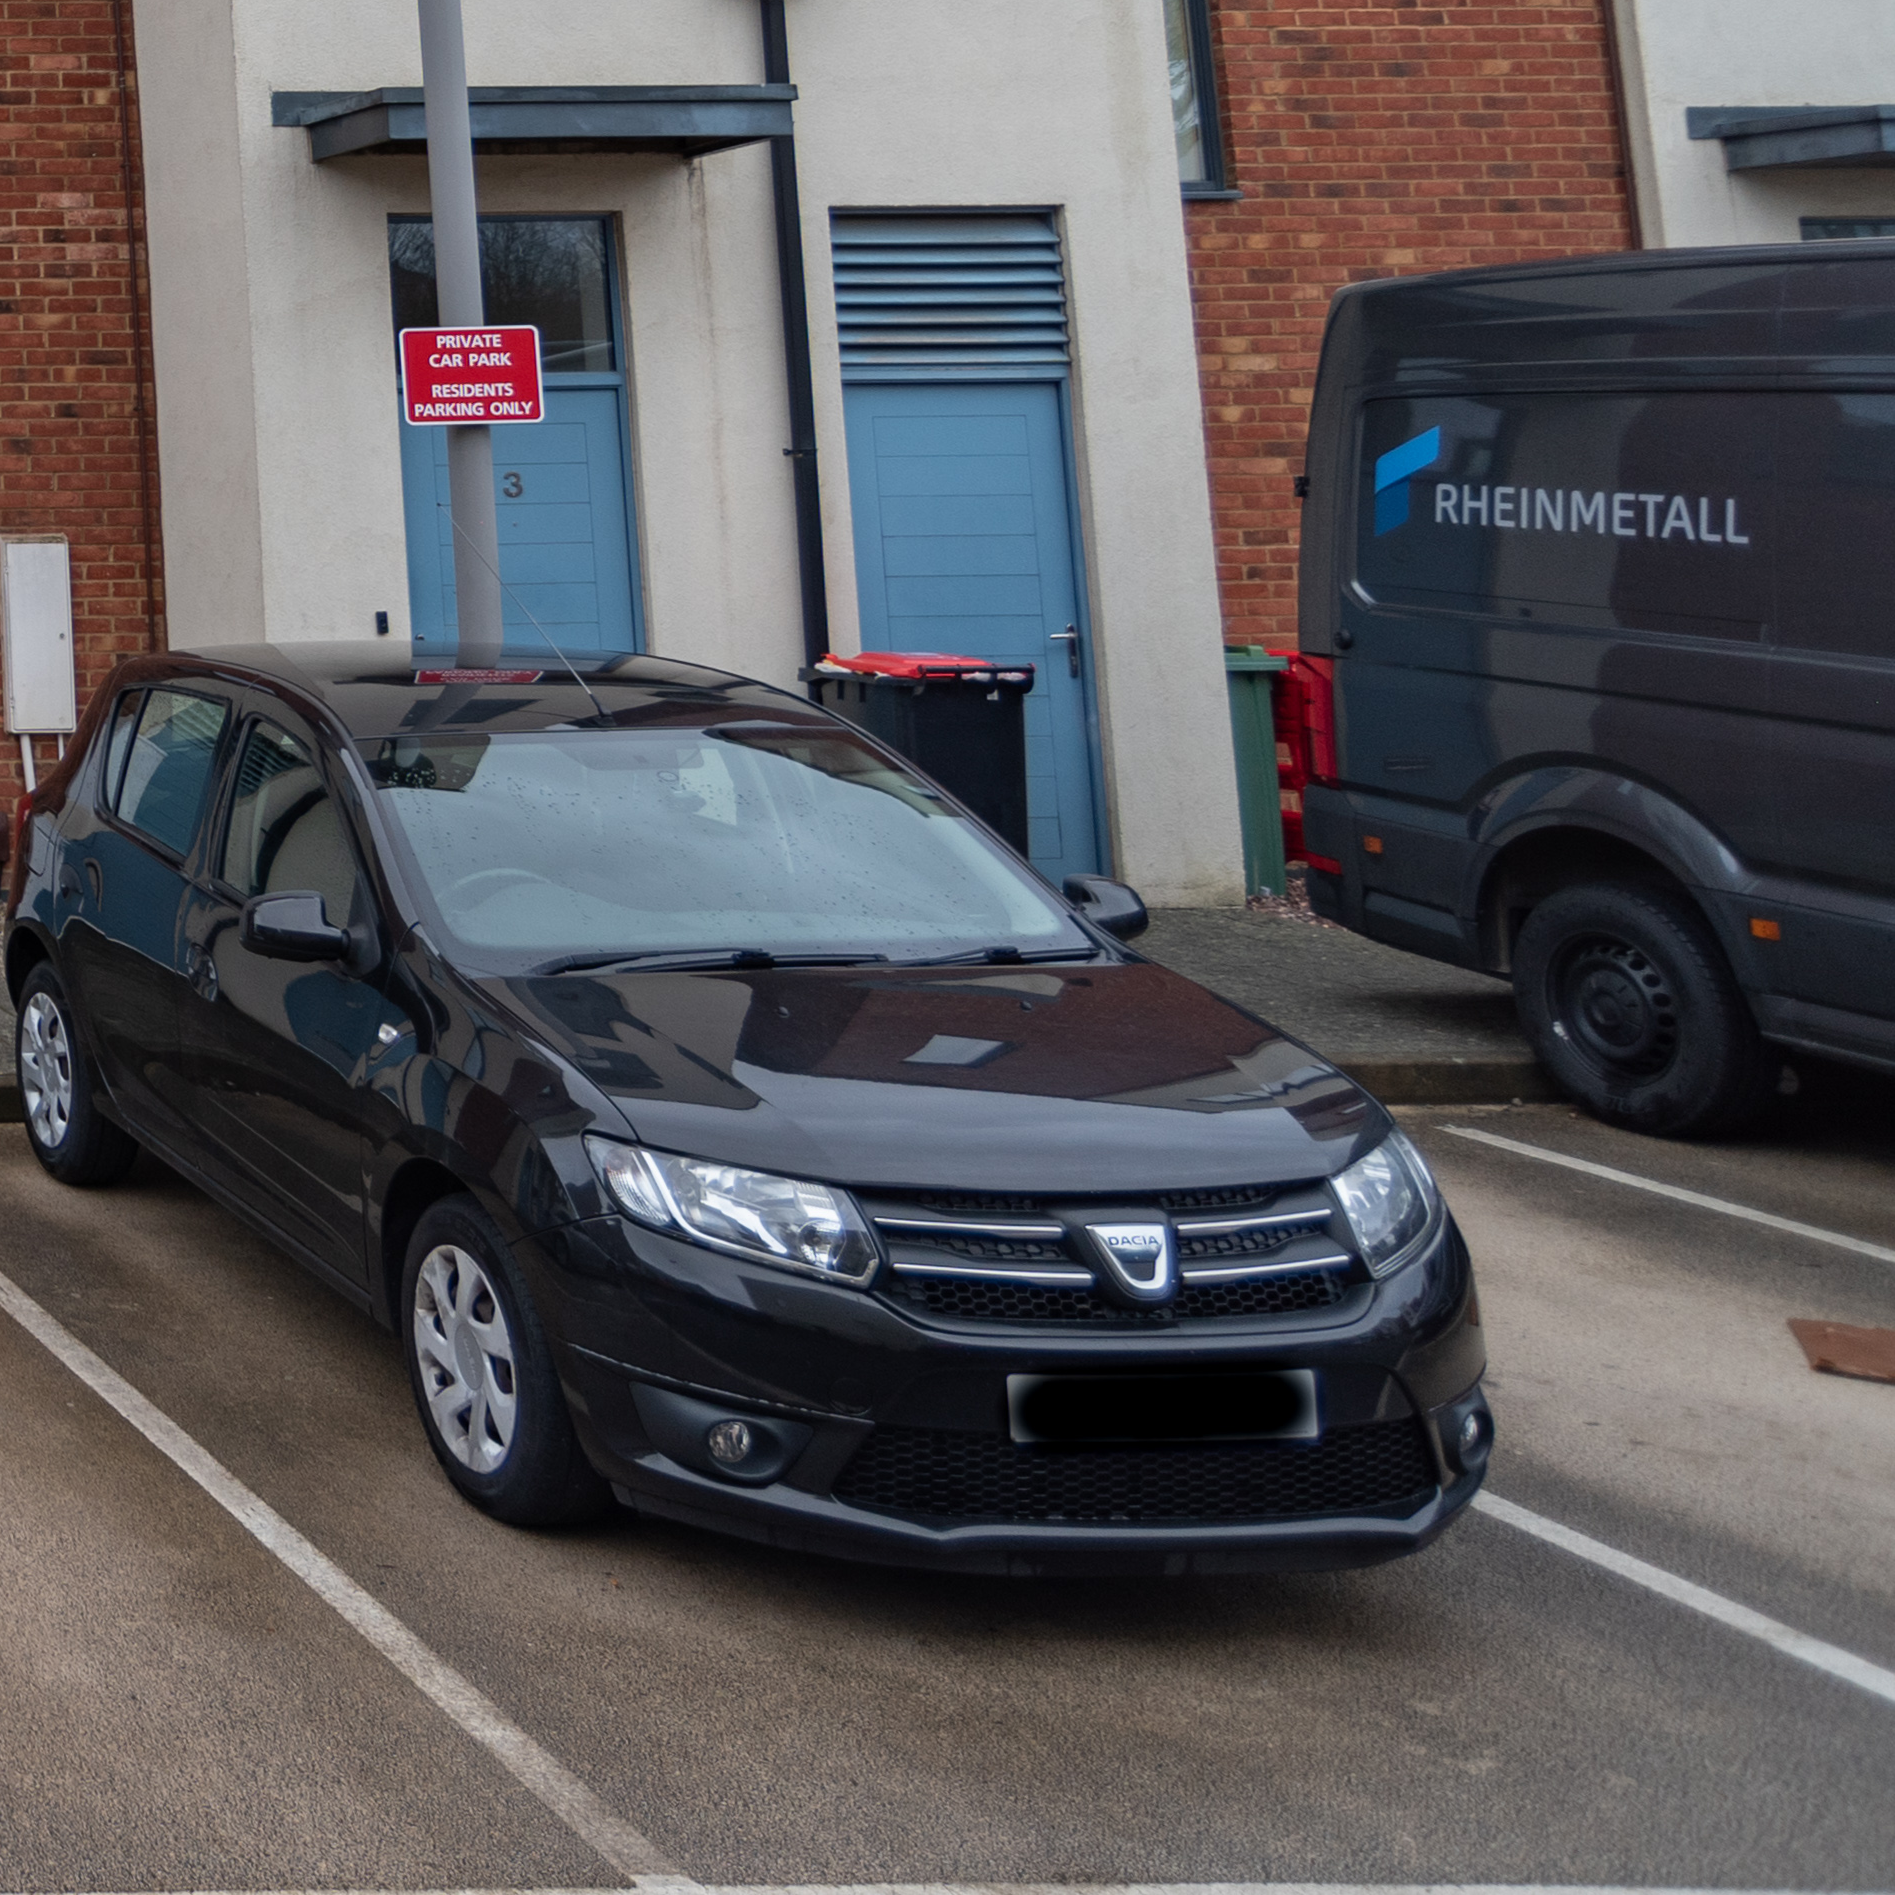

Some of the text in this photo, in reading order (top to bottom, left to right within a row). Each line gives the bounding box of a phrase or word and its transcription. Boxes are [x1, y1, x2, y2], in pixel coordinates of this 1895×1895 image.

[436, 334, 502, 349] PRIVATE
[428, 352, 512, 368] CAR PARK
[431, 383, 514, 398] RESIDENTS
[414, 401, 533, 417] PARKING ONLY
[503, 471, 523, 498] 3
[1434, 482, 1750, 545] RHEINMETALL
[1107, 1235, 1160, 1246] DACIA
